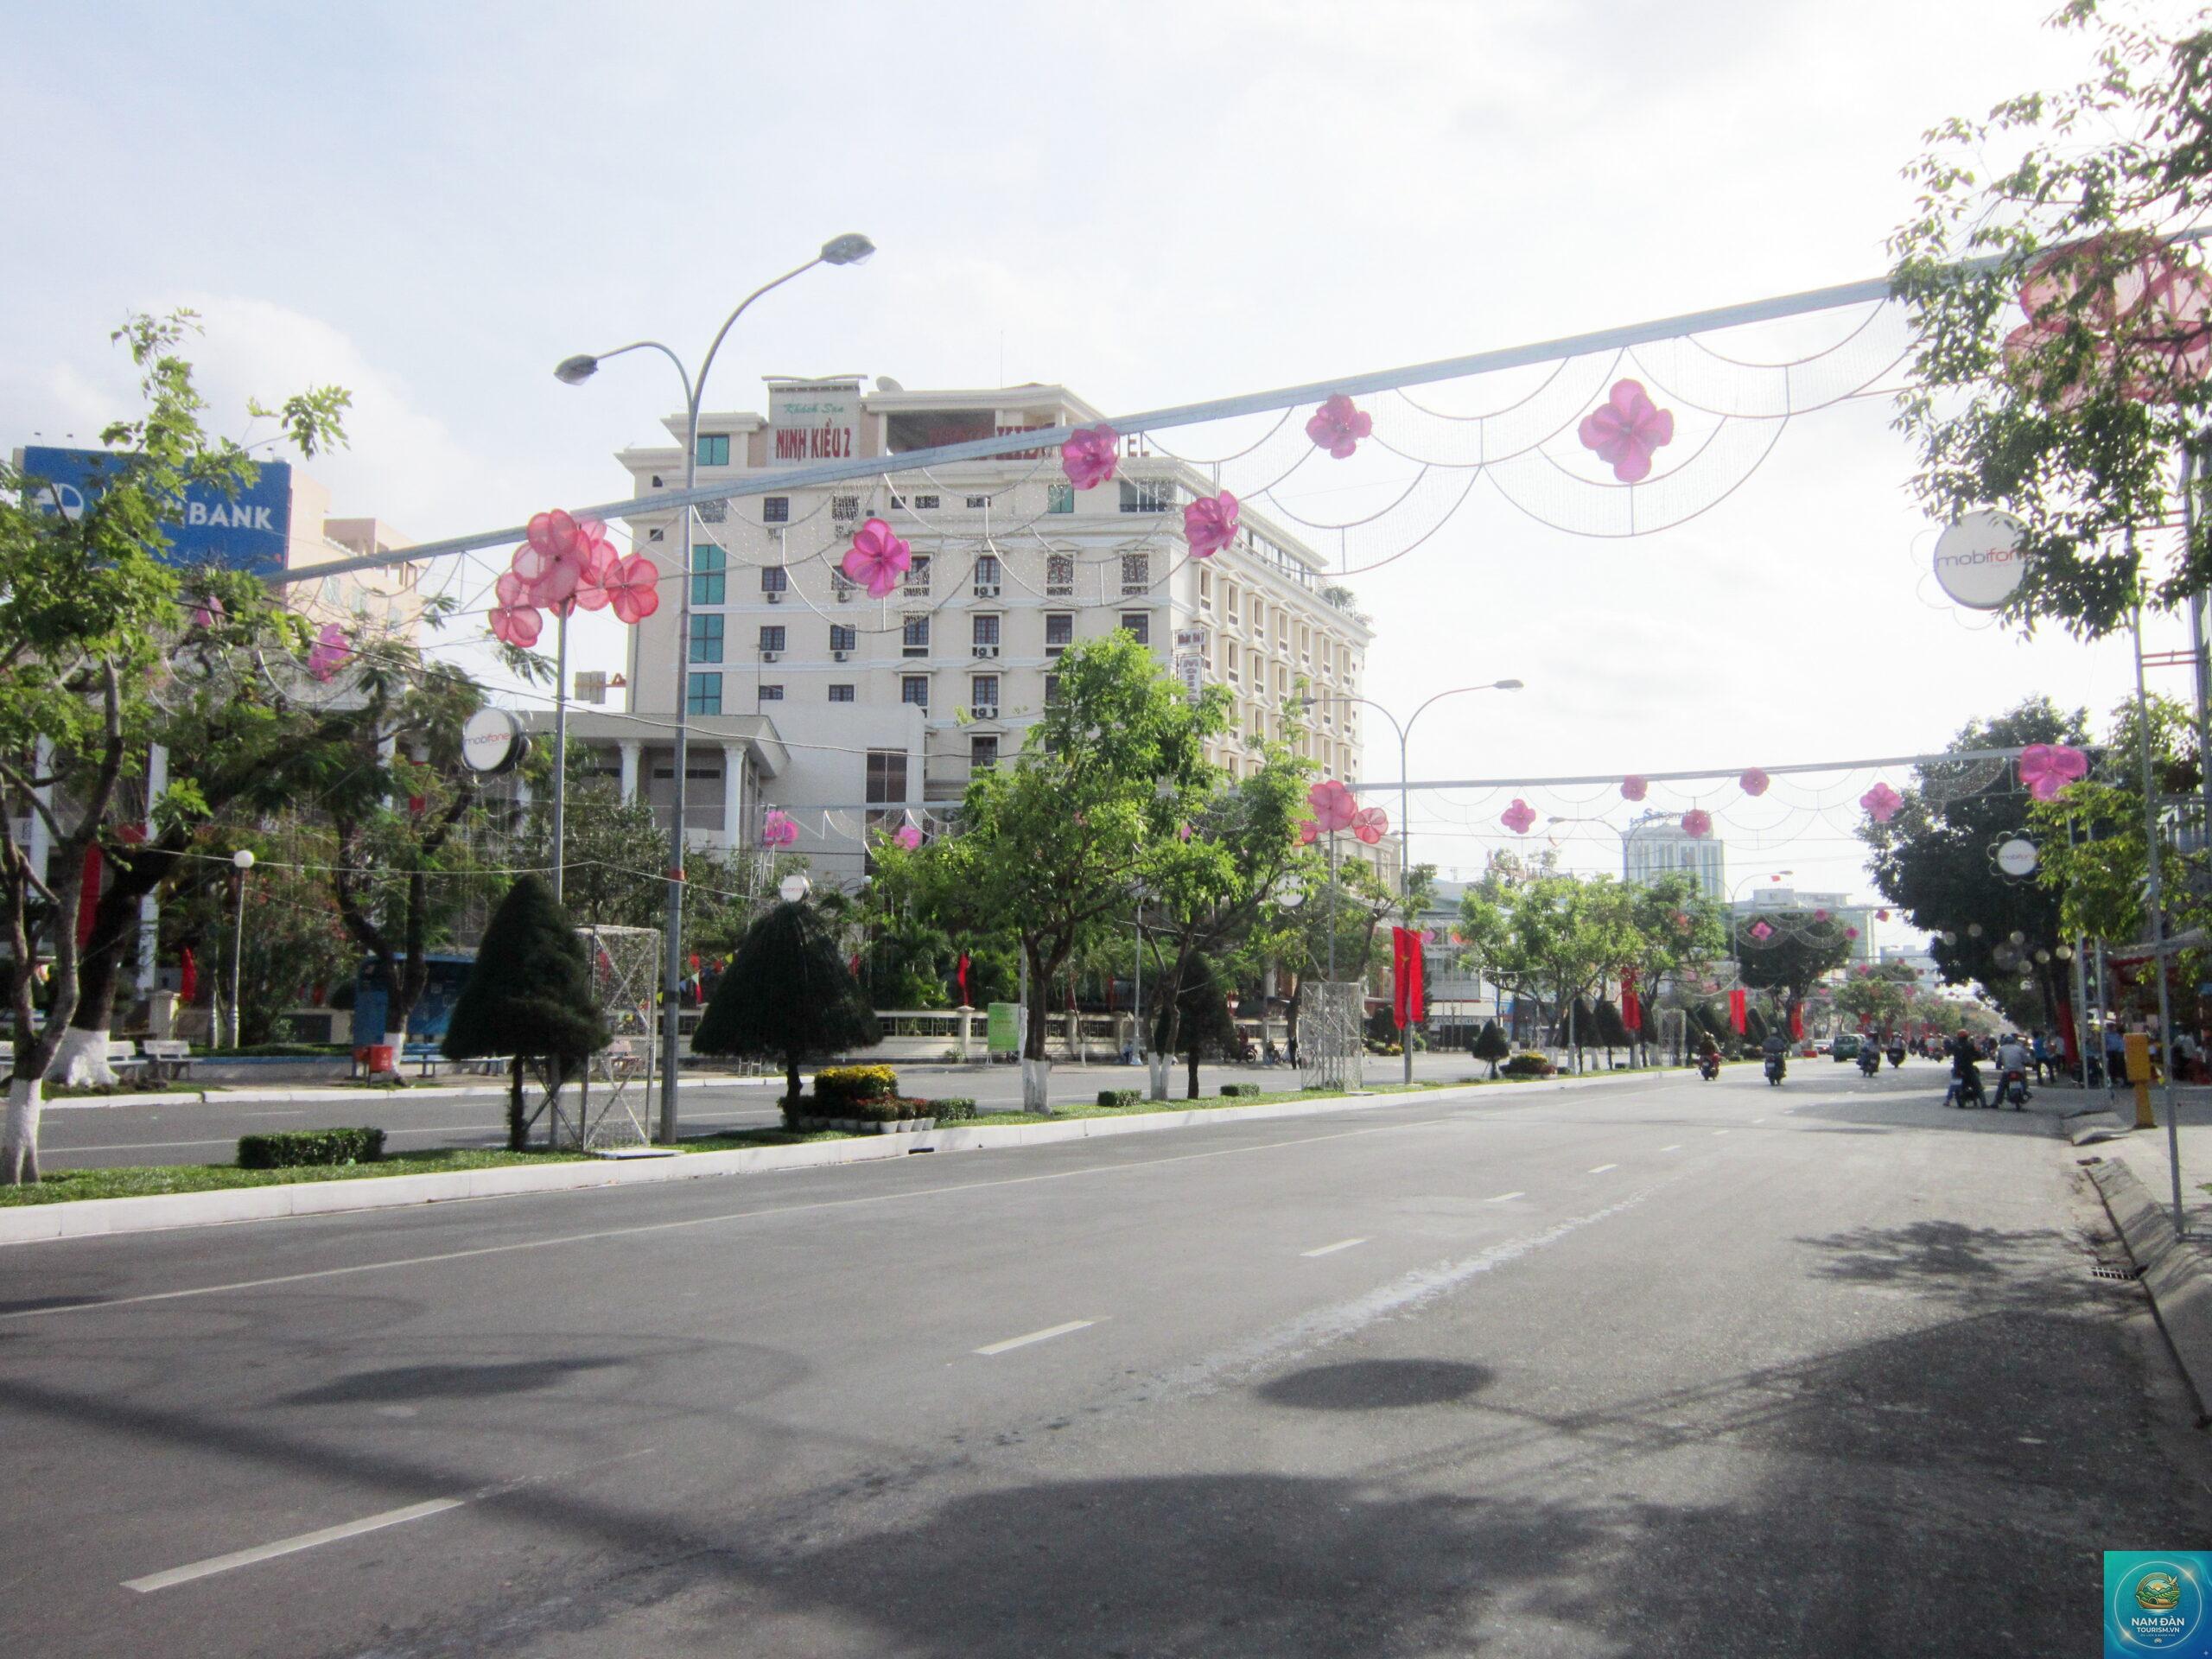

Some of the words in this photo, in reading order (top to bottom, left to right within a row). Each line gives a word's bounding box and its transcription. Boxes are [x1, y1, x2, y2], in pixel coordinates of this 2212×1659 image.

[776, 429, 806, 461] NINH
[843, 428, 851, 458] 2
[164, 500, 273, 530] BANK
[1936, 547, 2022, 567] mobifon
